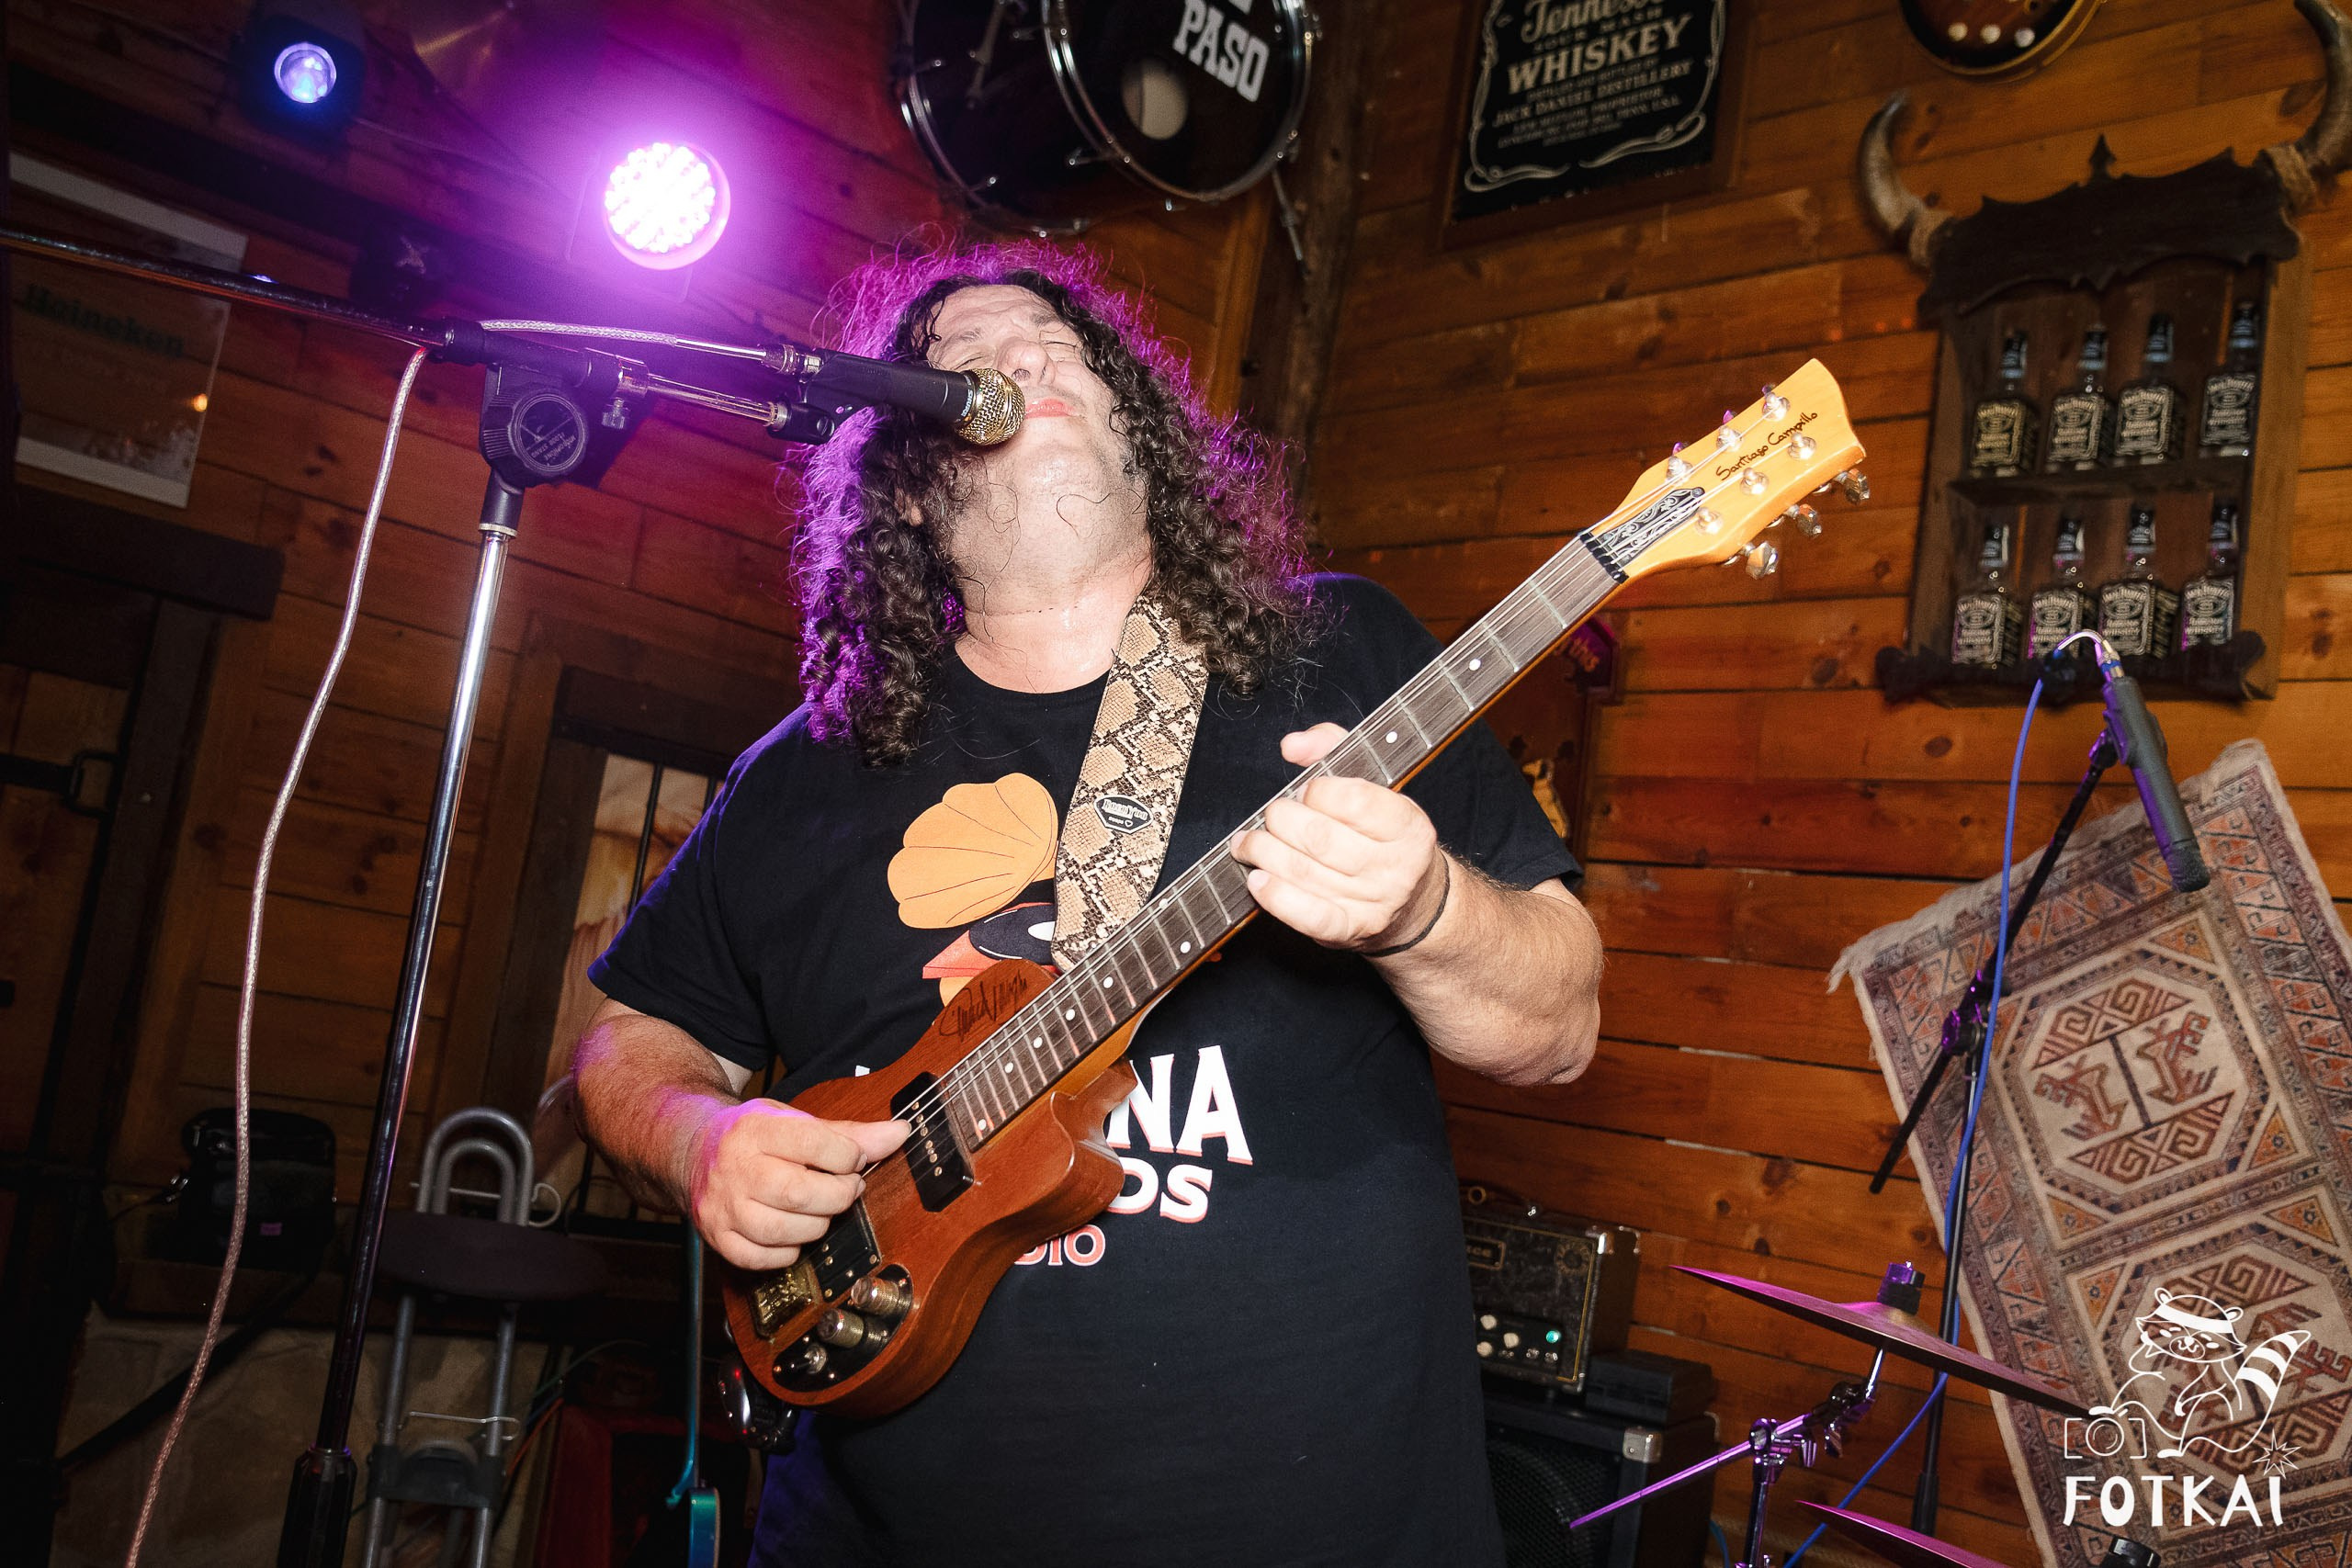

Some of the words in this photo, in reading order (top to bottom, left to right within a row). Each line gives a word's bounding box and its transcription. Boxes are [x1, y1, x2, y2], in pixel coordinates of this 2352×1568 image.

[1172, 0, 1269, 103] PASO
[1508, 12, 1692, 95] WHISKEY
[1715, 445, 1770, 481] Santiago
[1767, 412, 1818, 446] Campillo
